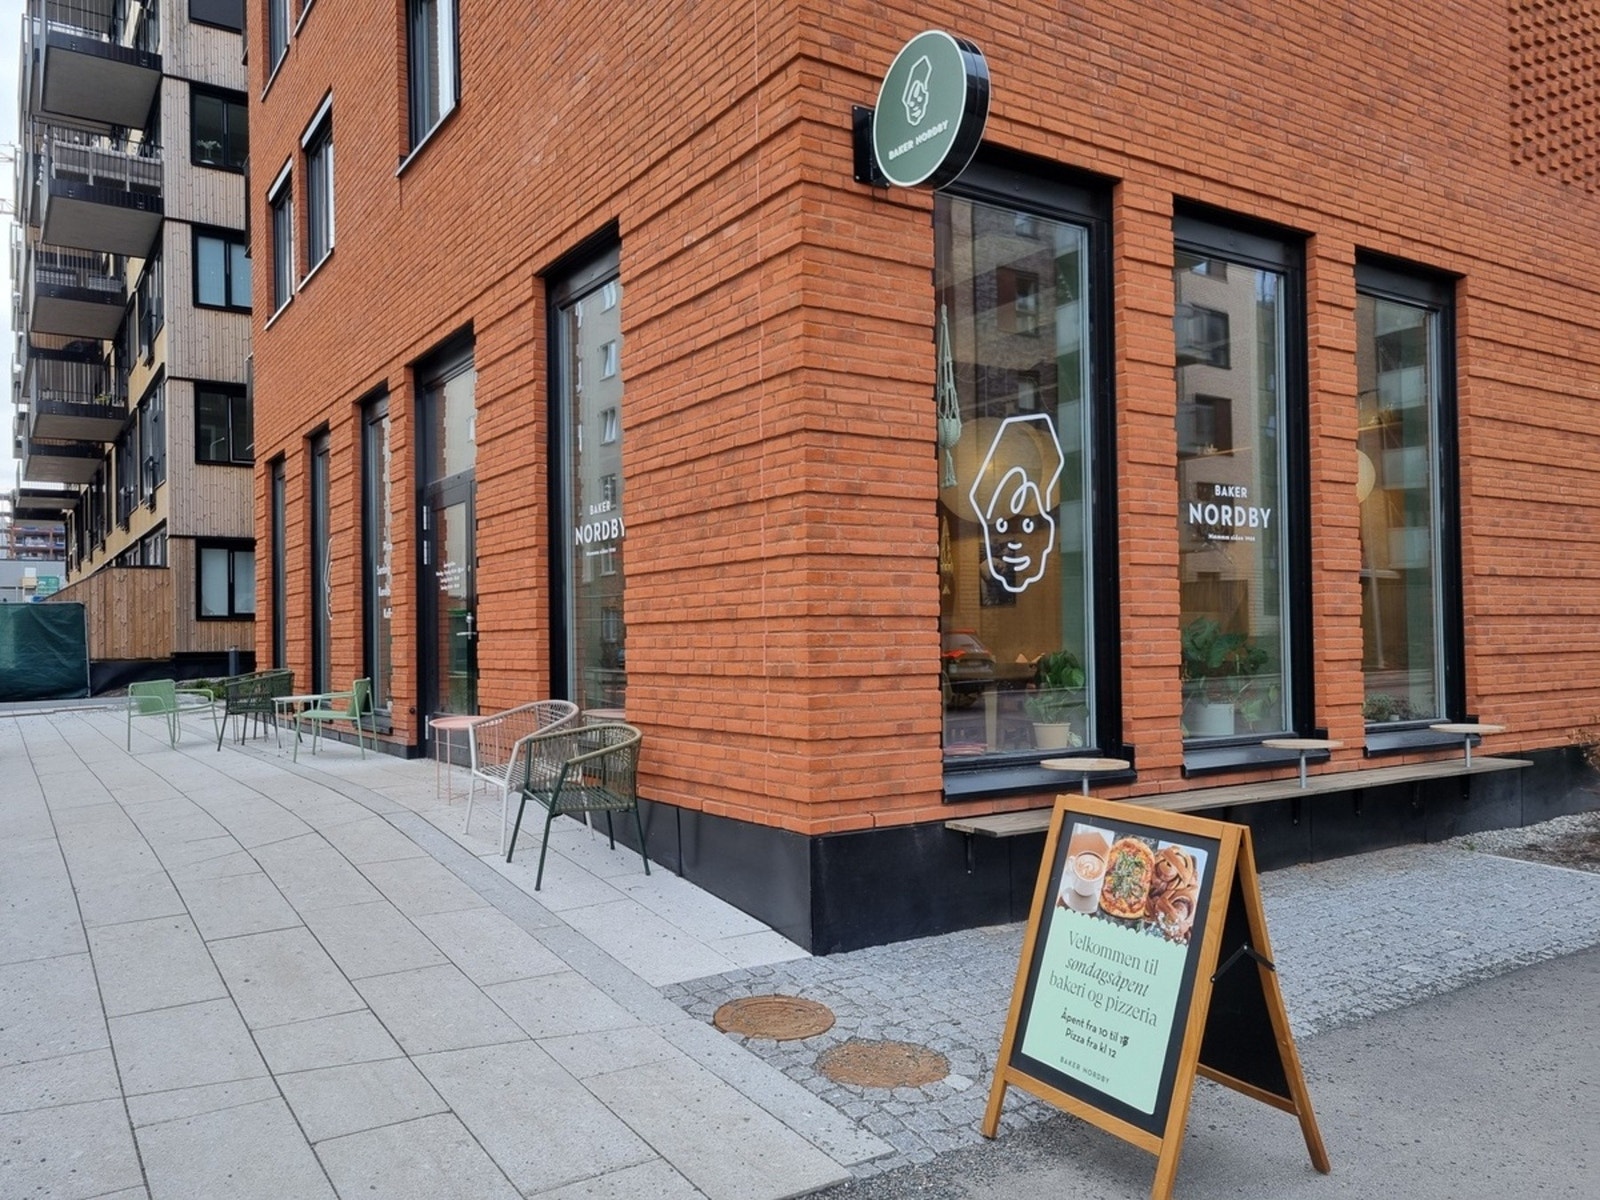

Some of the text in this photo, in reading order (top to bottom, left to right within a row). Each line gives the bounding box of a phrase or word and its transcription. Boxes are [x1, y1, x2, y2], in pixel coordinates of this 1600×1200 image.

[888, 120, 948, 160] BAKER NORDBY
[1214, 484, 1248, 498] BAKER
[589, 500, 611, 515] BAKER
[1189, 503, 1271, 529] NORDBY
[575, 517, 625, 546] NORDBY
[1068, 930, 1159, 976] Velkommen til
[1065, 957, 1149, 997] søndagsåpent
[1049, 970, 1157, 1027] bakeri og pizzeria
[1061, 1007, 1085, 1028] Åpent
[1086, 1019, 1097, 1033] fra
[1099, 1027, 1108, 1037] 10
[1109, 1030, 1119, 1042] til
[1065, 1027, 1117, 1058] Pizza fra kl 12
[1060, 1056, 1110, 1084] BAKER NORDBY
